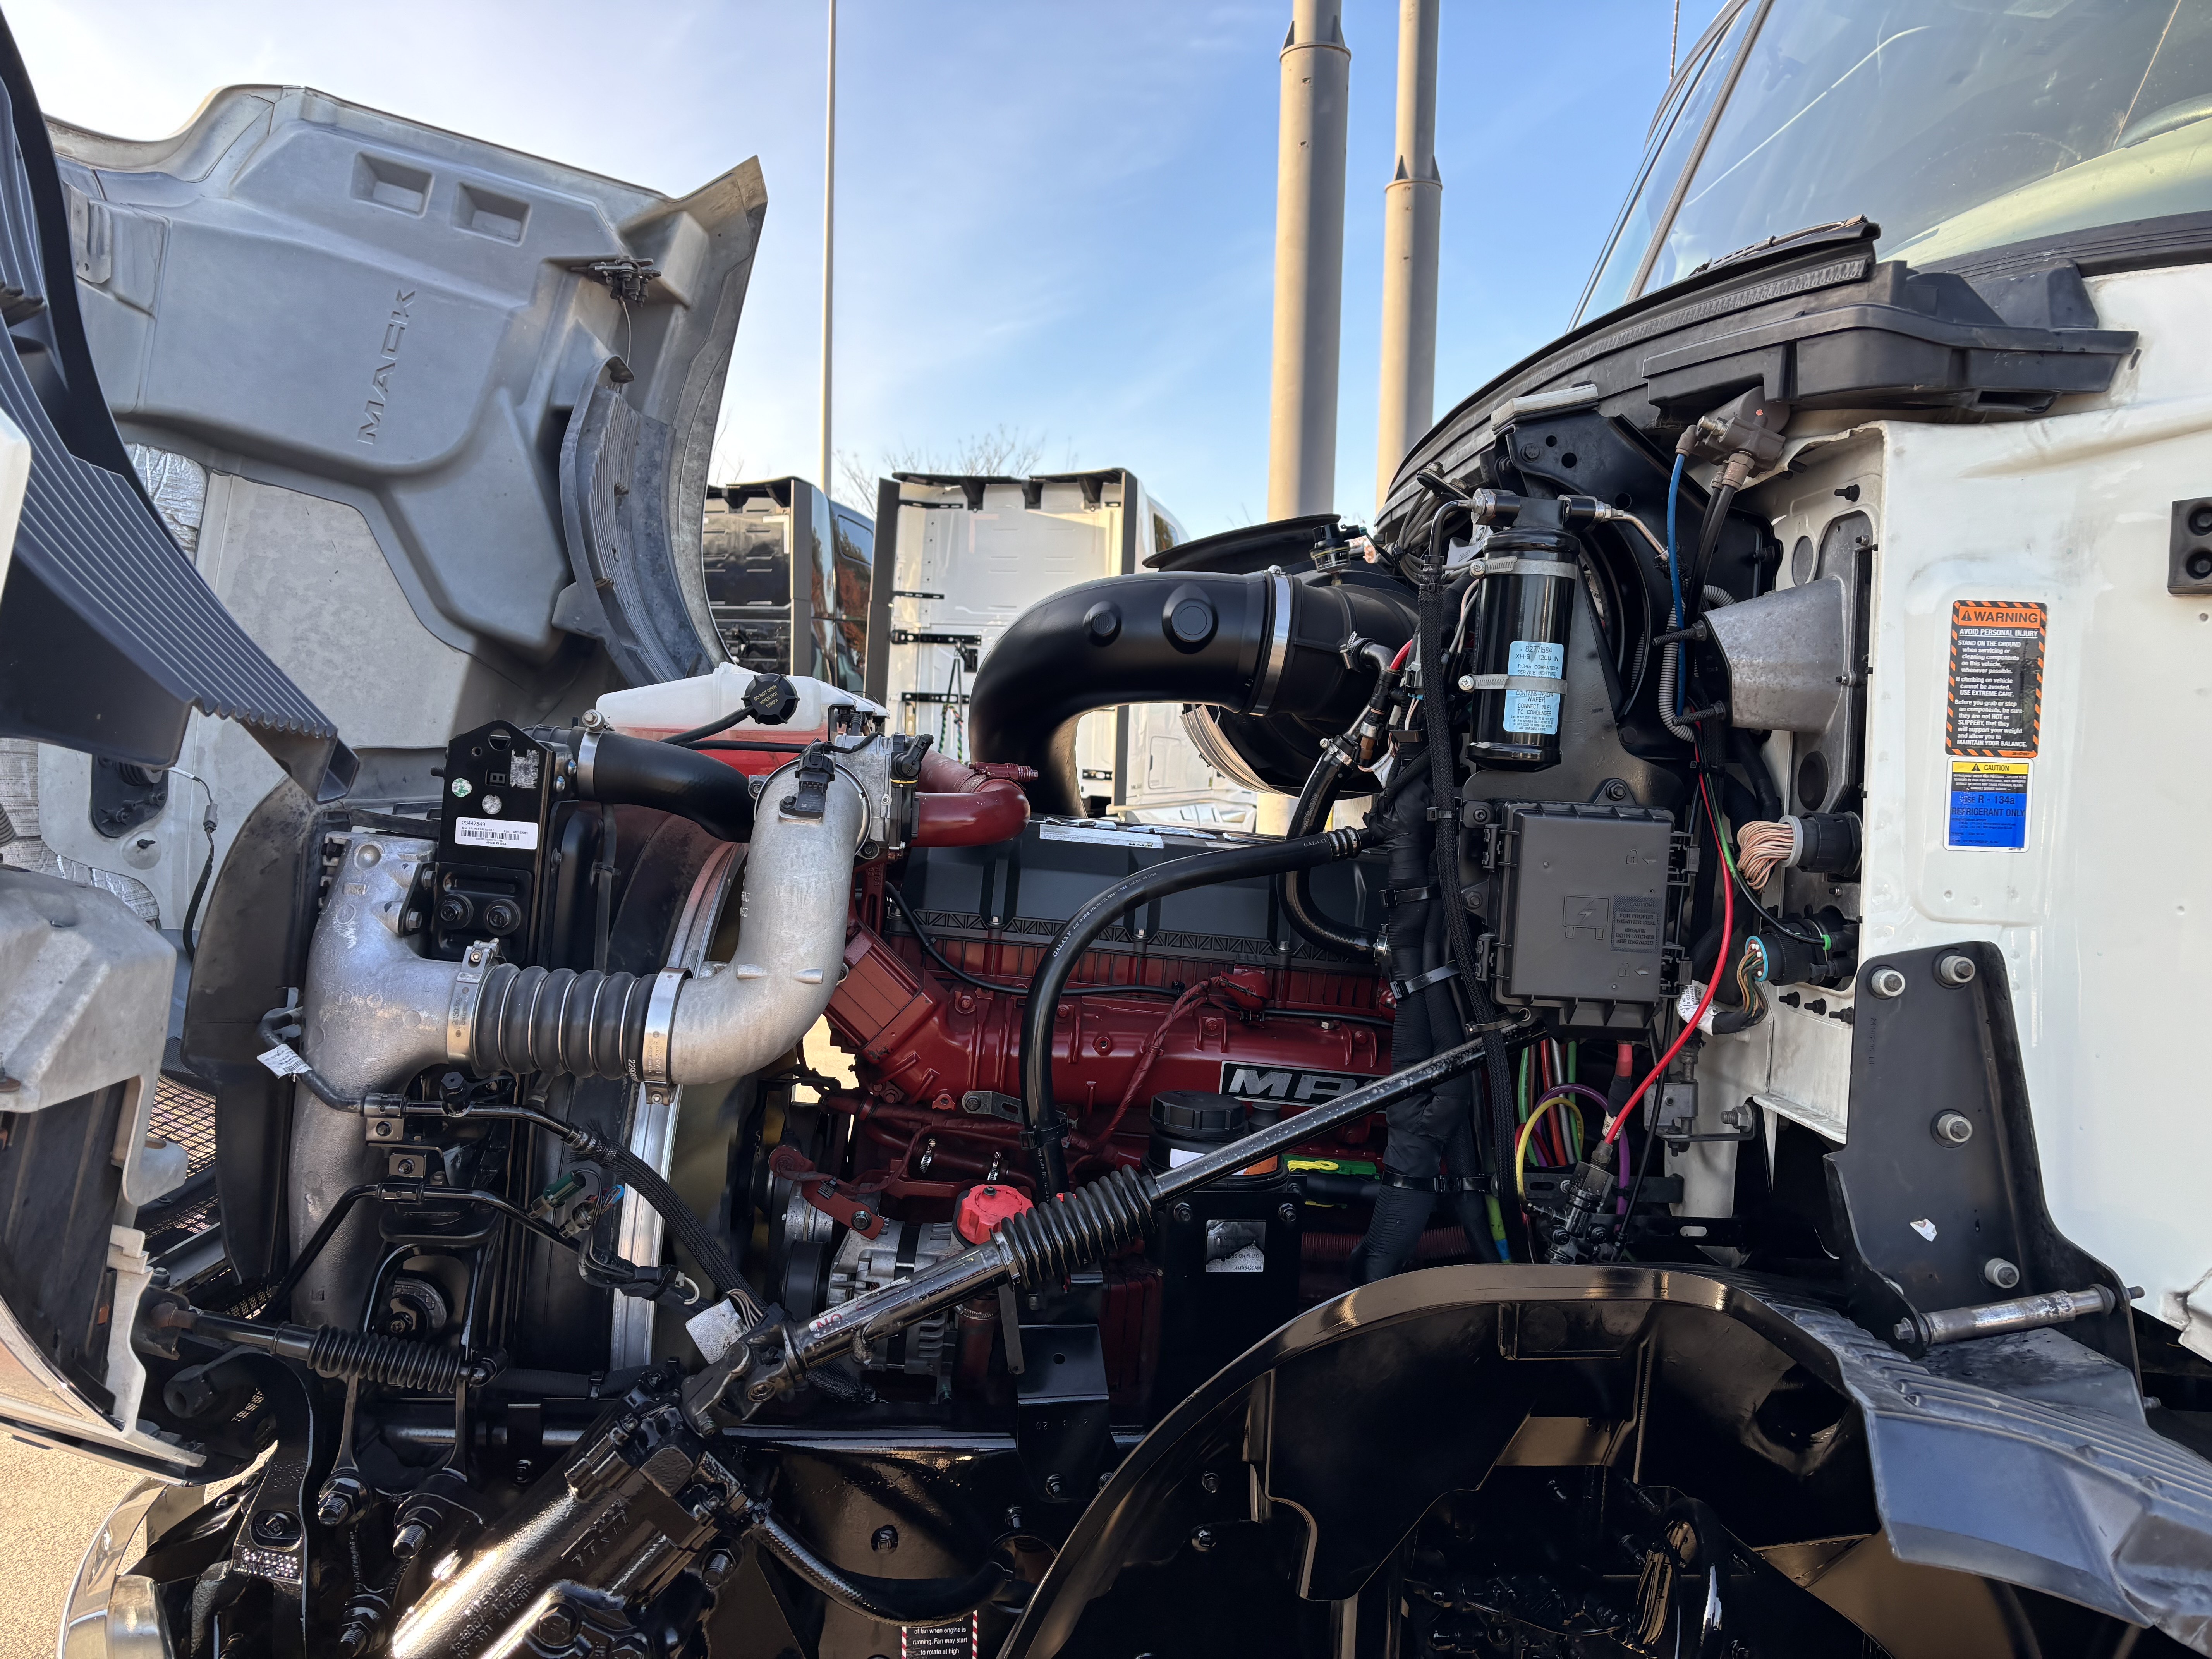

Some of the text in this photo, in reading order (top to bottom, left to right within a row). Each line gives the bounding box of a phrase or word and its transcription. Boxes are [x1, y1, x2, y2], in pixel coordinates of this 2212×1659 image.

[357, 289, 416, 445] MACK
[1974, 611, 2038, 623] WARNING
[767, 684, 777, 693] OPEN
[759, 695, 771, 705] WHEN
[1978, 795, 1984, 804] R
[1994, 795, 2015, 804] 134a
[1951, 807, 2025, 817] REFRIGERANT ONLY
[1304, 838, 1327, 847] GALAXY
[1053, 930, 1072, 957] GALAXY
[1229, 1066, 1379, 1101] MP
